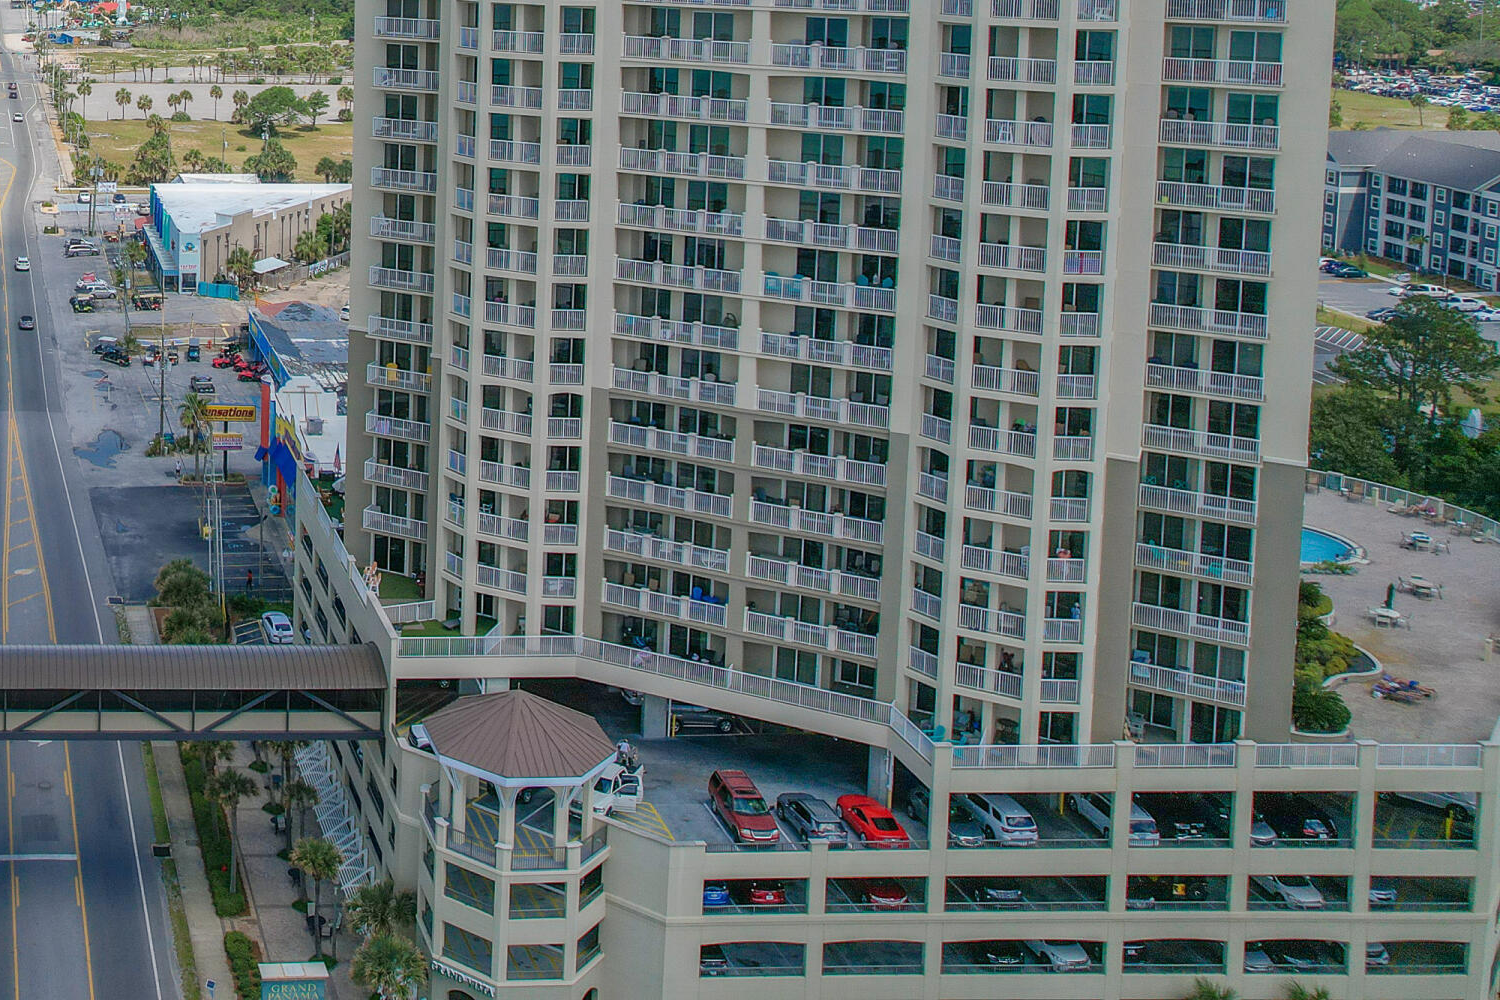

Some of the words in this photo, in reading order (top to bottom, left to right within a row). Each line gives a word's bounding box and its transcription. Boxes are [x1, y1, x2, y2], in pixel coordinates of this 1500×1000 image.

[204, 407, 254, 417] unsations
[271, 983, 317, 993] GRAND
[268, 991, 319, 1000] PANAMA
